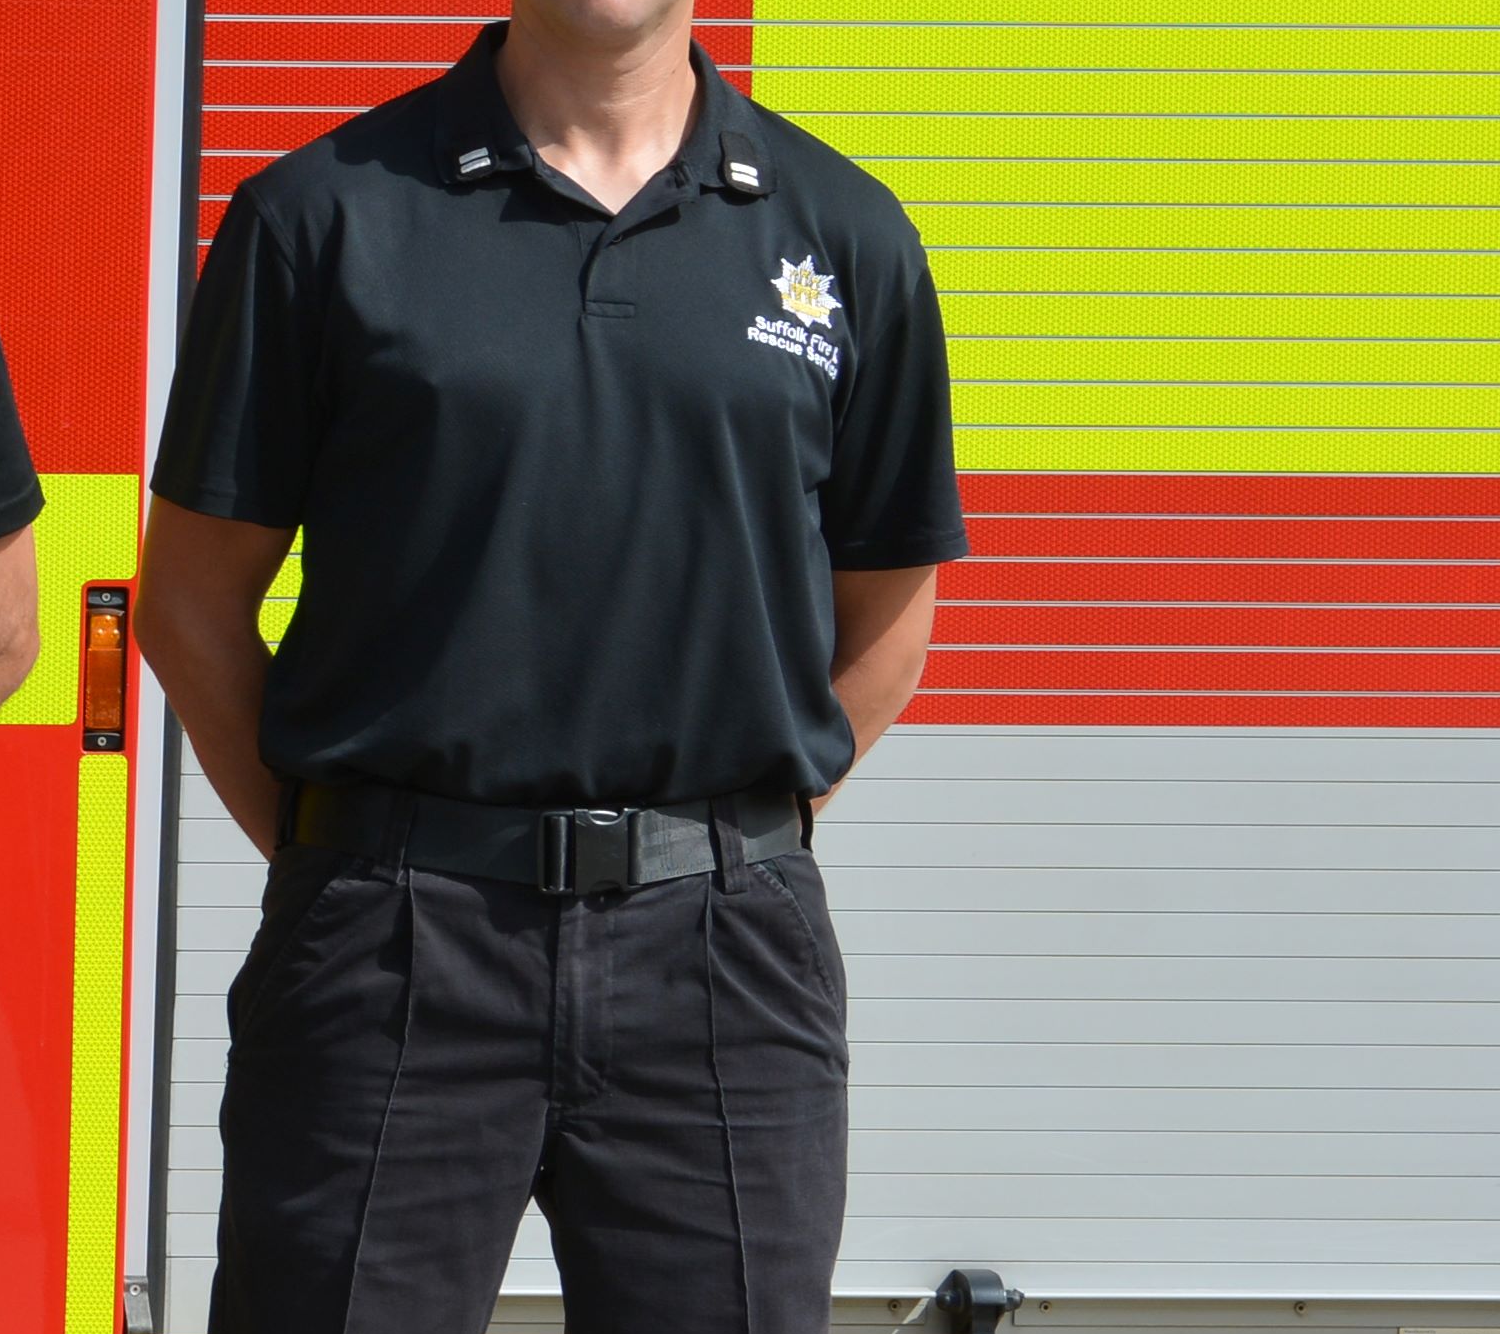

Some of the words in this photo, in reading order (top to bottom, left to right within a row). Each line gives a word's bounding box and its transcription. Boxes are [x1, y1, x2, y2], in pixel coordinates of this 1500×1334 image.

[747, 326, 803, 356] Rescue
[755, 315, 809, 345] Suffolk
[810, 333, 833, 357] Fire
